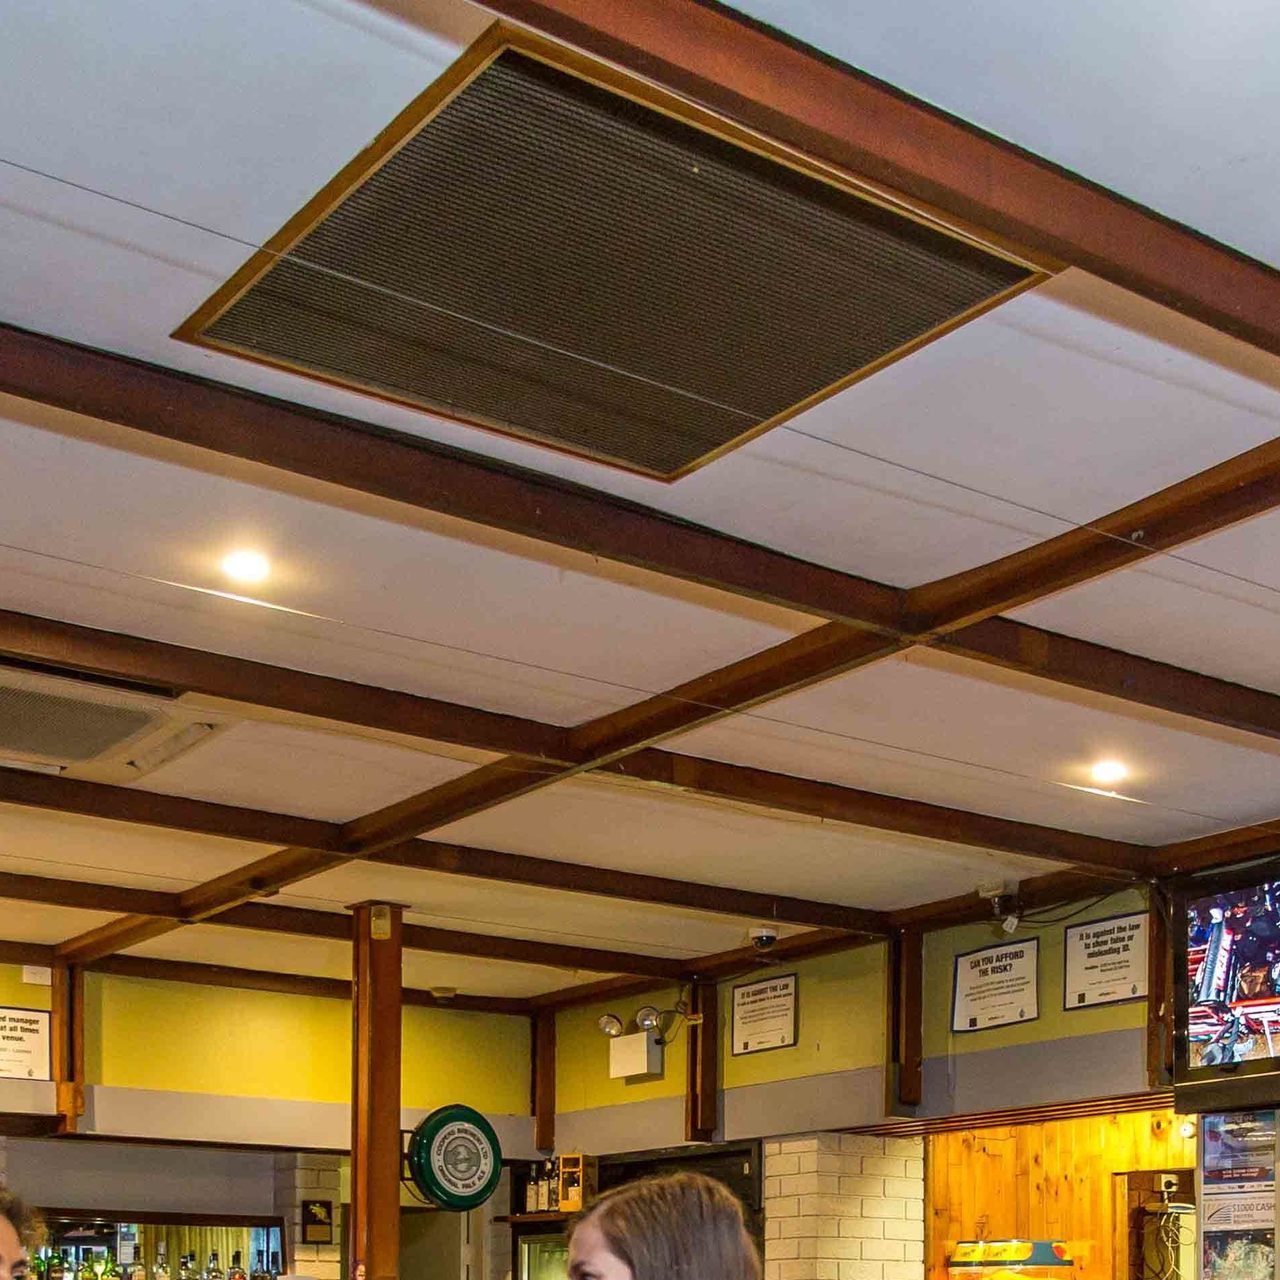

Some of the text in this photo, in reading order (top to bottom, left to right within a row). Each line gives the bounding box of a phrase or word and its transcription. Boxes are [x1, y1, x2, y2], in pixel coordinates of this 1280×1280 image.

[970, 950, 1025, 970] CAN YOU AFFORD
[979, 964, 1013, 978] THE RISK?
[9, 1018, 40, 1026] manager
[20, 1026, 40, 1035] times
[1256, 1203, 1276, 1212] CASH
